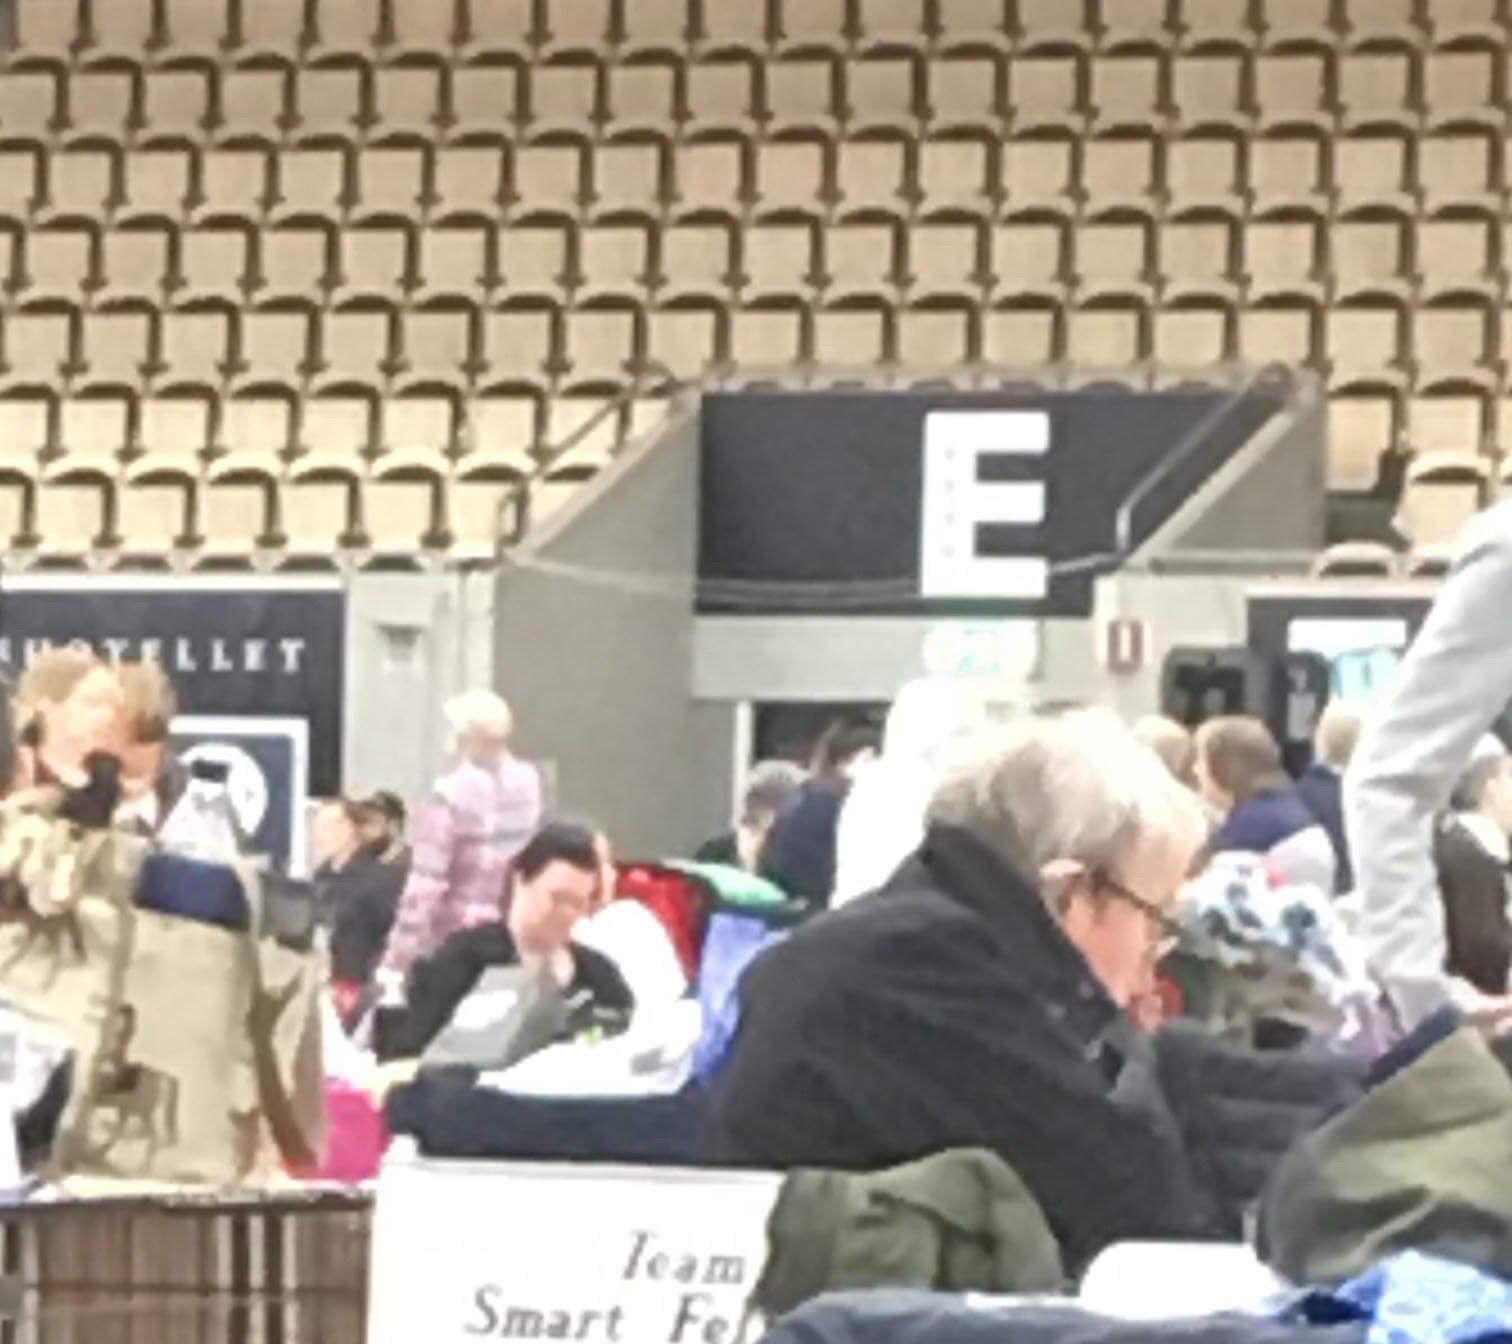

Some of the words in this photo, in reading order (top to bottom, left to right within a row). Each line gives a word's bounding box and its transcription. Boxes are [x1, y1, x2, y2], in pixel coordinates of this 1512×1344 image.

[921, 411, 1050, 598] E
[622, 1230, 745, 1284] Team
[463, 1284, 624, 1342] Smart
